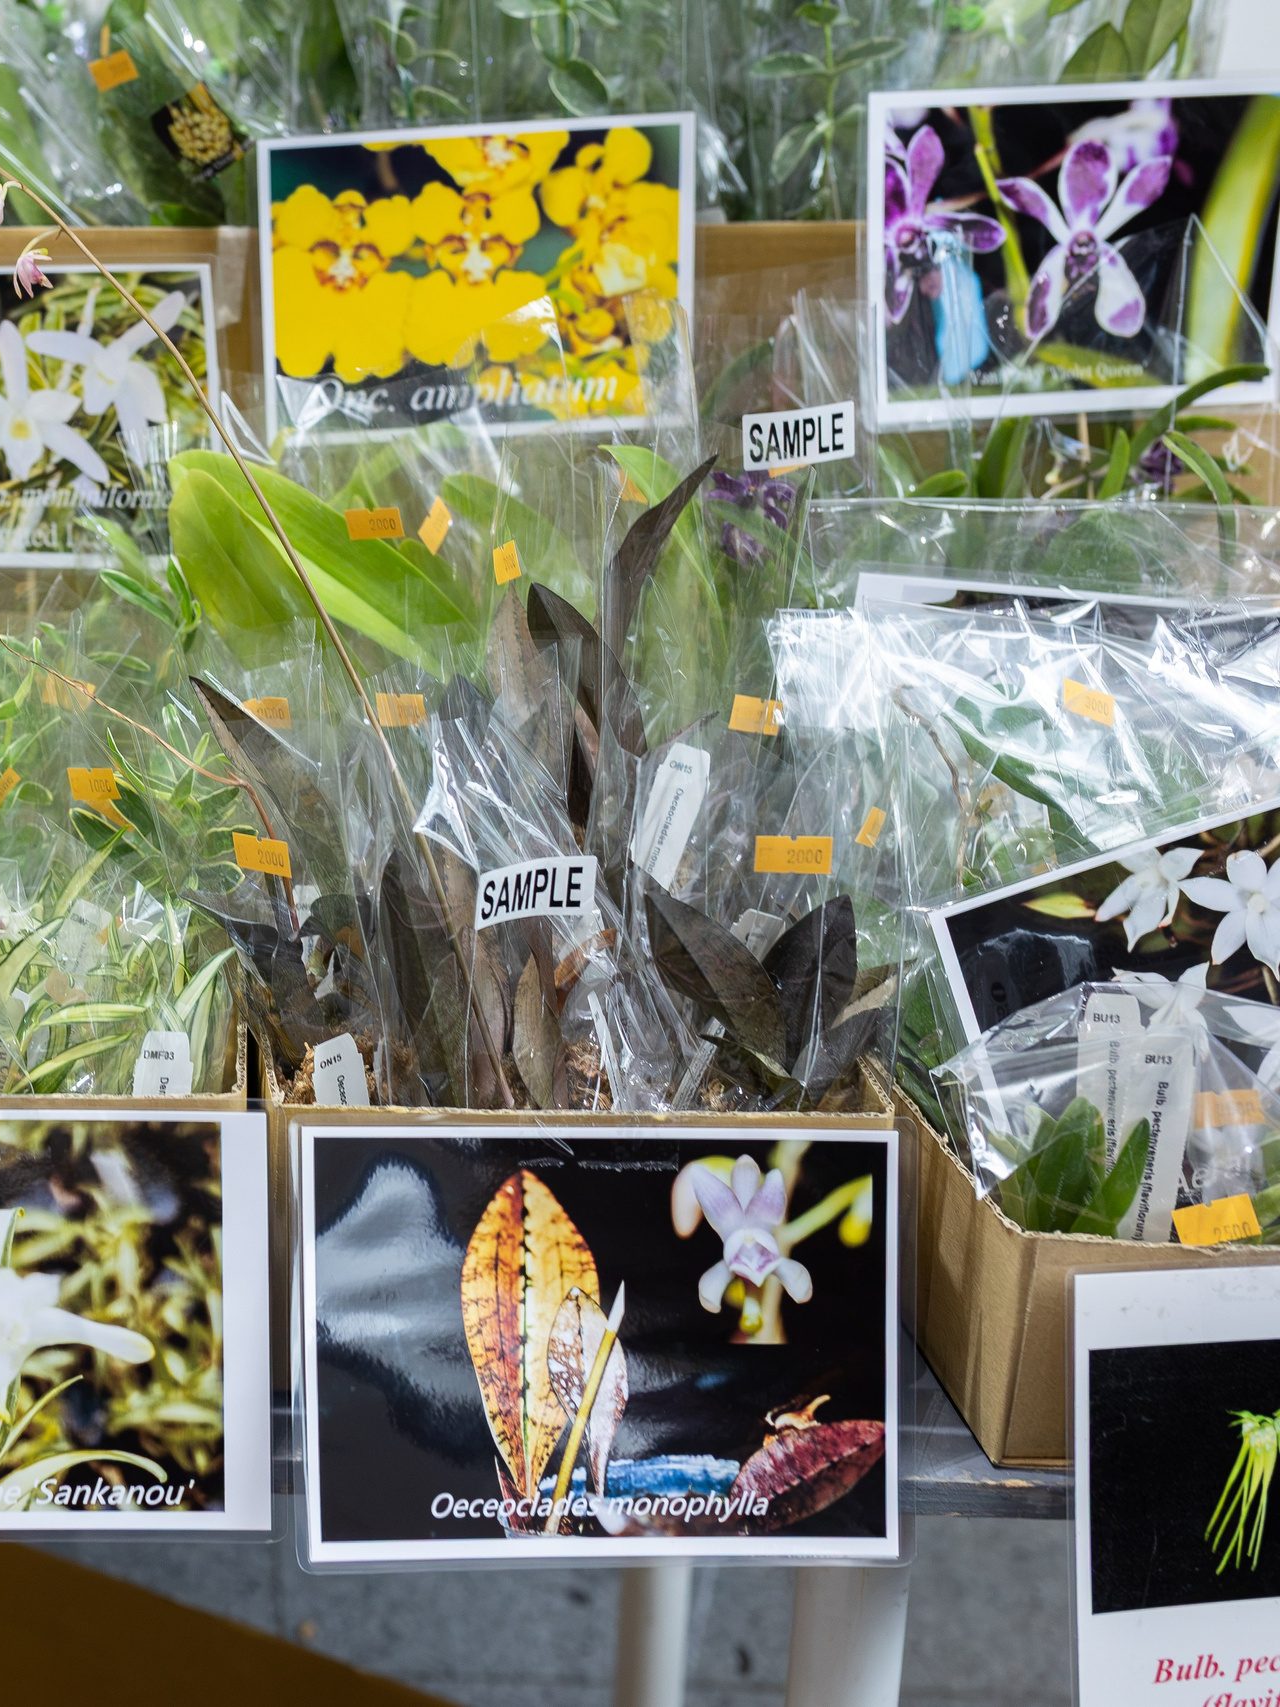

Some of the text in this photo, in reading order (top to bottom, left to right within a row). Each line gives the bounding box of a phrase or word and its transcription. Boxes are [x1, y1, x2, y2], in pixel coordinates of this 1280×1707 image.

[749, 412, 845, 463] SAMPLE
[369, 517, 396, 531] 2000
[1085, 695, 1109, 717] 3000
[88, 779, 112, 793] 1000
[646, 787, 684, 873] Oeceoclades mono
[257, 849, 285, 868] 2000
[787, 848, 823, 866] 2000
[481, 866, 583, 921] SAMPLE
[1092, 1013, 1121, 1024] BU13
[143, 1050, 175, 1061] DMF03
[320, 1053, 343, 1070] ON15
[1144, 1054, 1173, 1066] BU13
[1155, 1079, 1168, 1108] Bulb.
[1105, 1136, 1116, 1175] (flaviflo
[1134, 1180, 1153, 1242] (flaviflorum)
[32, 1477, 195, 1508] 'Sankanou'
[430, 1490, 770, 1523] Oeceoclades monophylla
[1152, 1653, 1280, 1684] Bulb. pec
